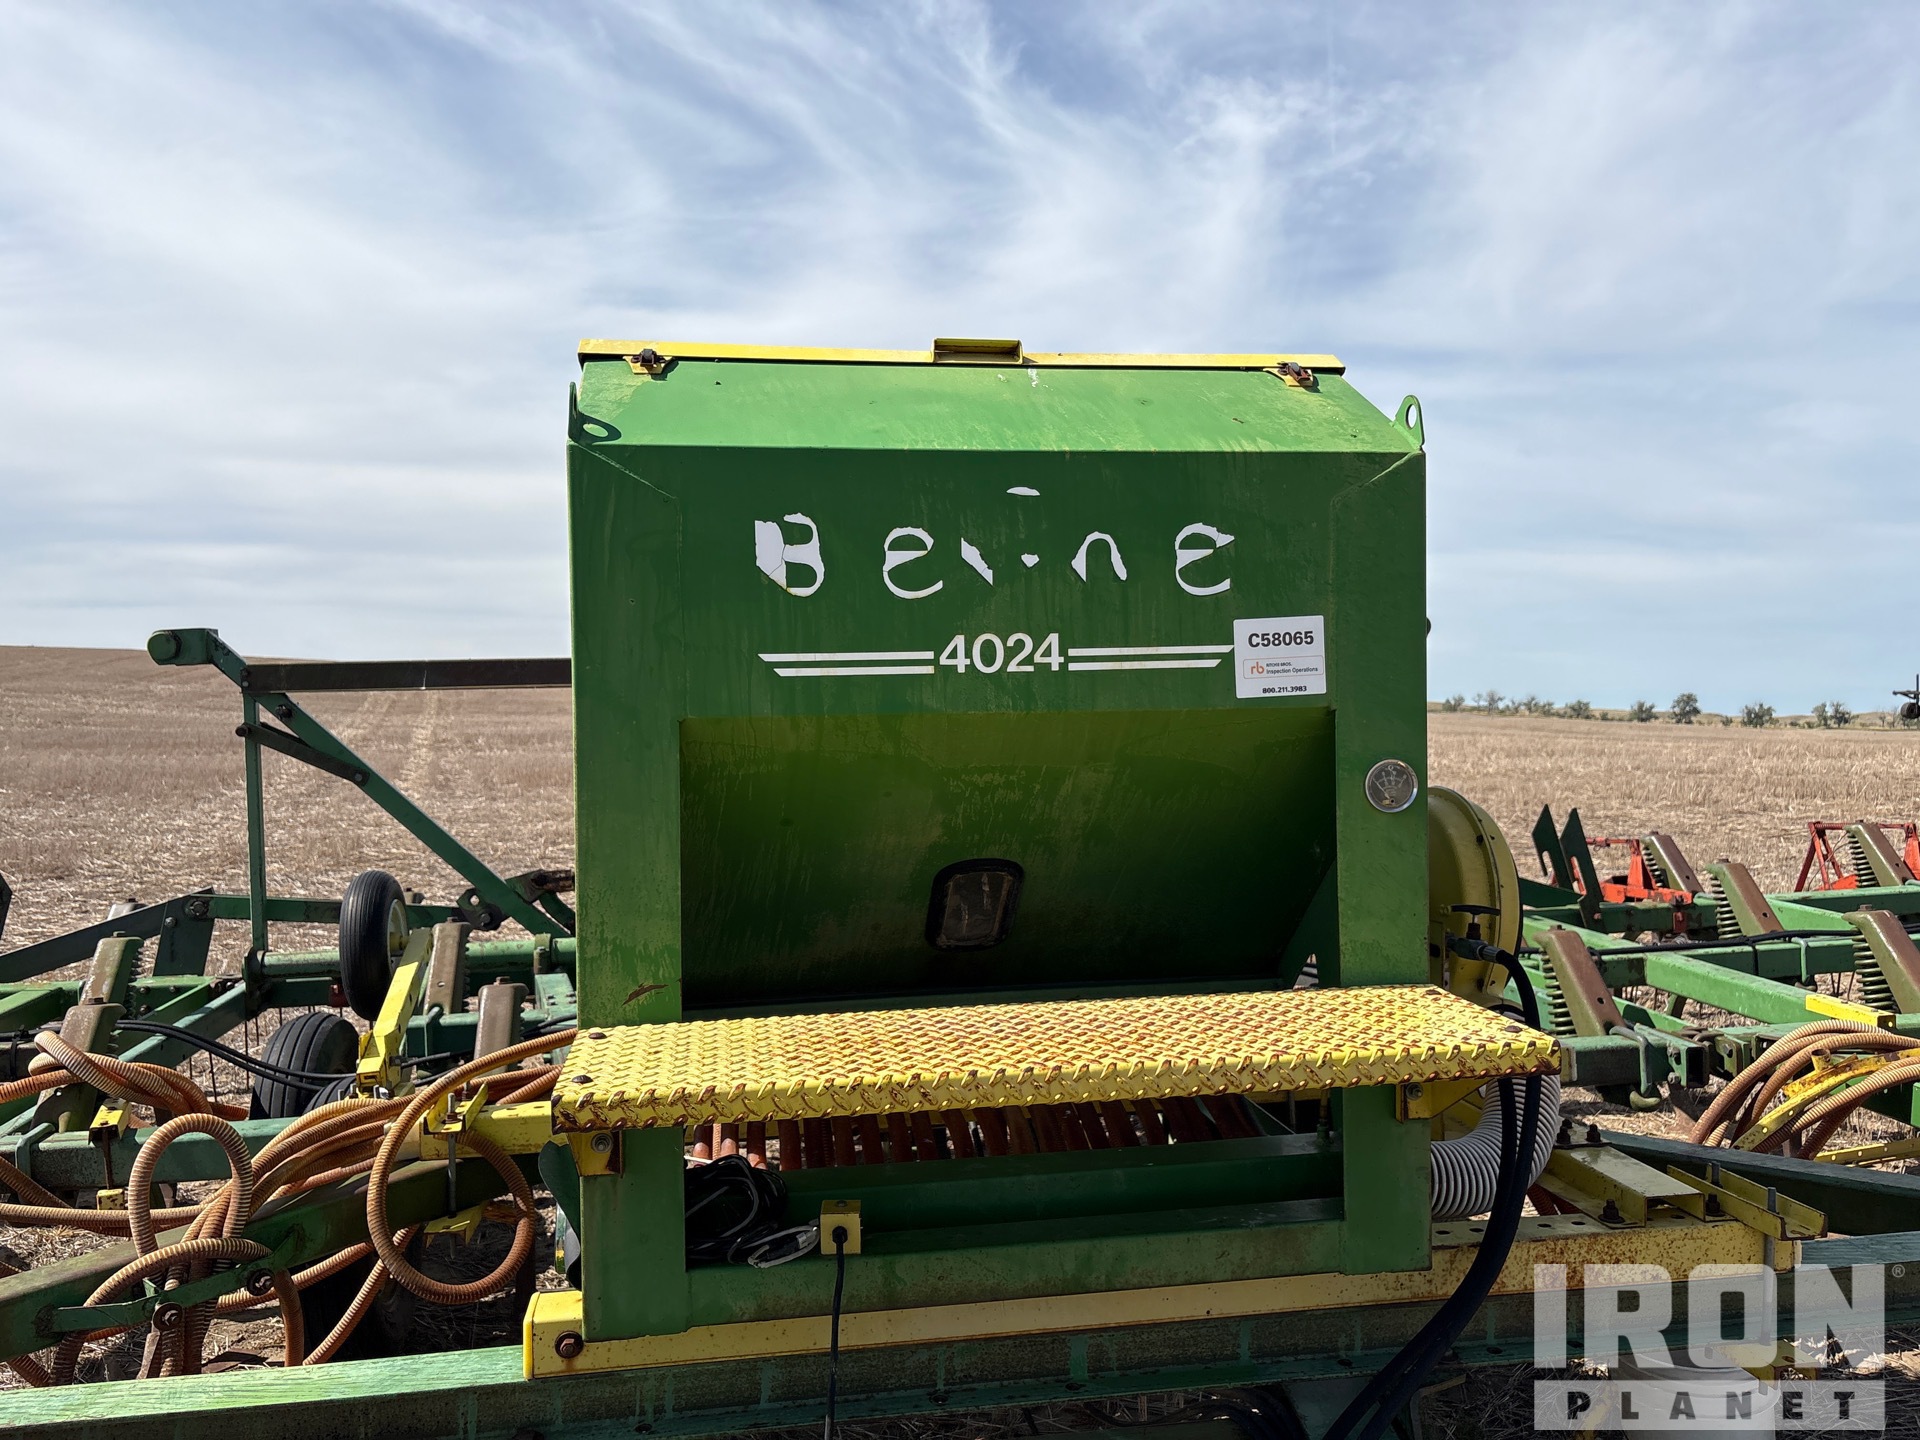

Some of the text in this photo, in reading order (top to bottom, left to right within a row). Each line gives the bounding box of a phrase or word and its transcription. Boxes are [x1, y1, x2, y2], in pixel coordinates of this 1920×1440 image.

[1248, 631, 1314, 648] C58065
[939, 633, 1064, 674] 4024
[1250, 661, 1265, 675] rb
[1262, 685, 1307, 694] 800.211.3983
